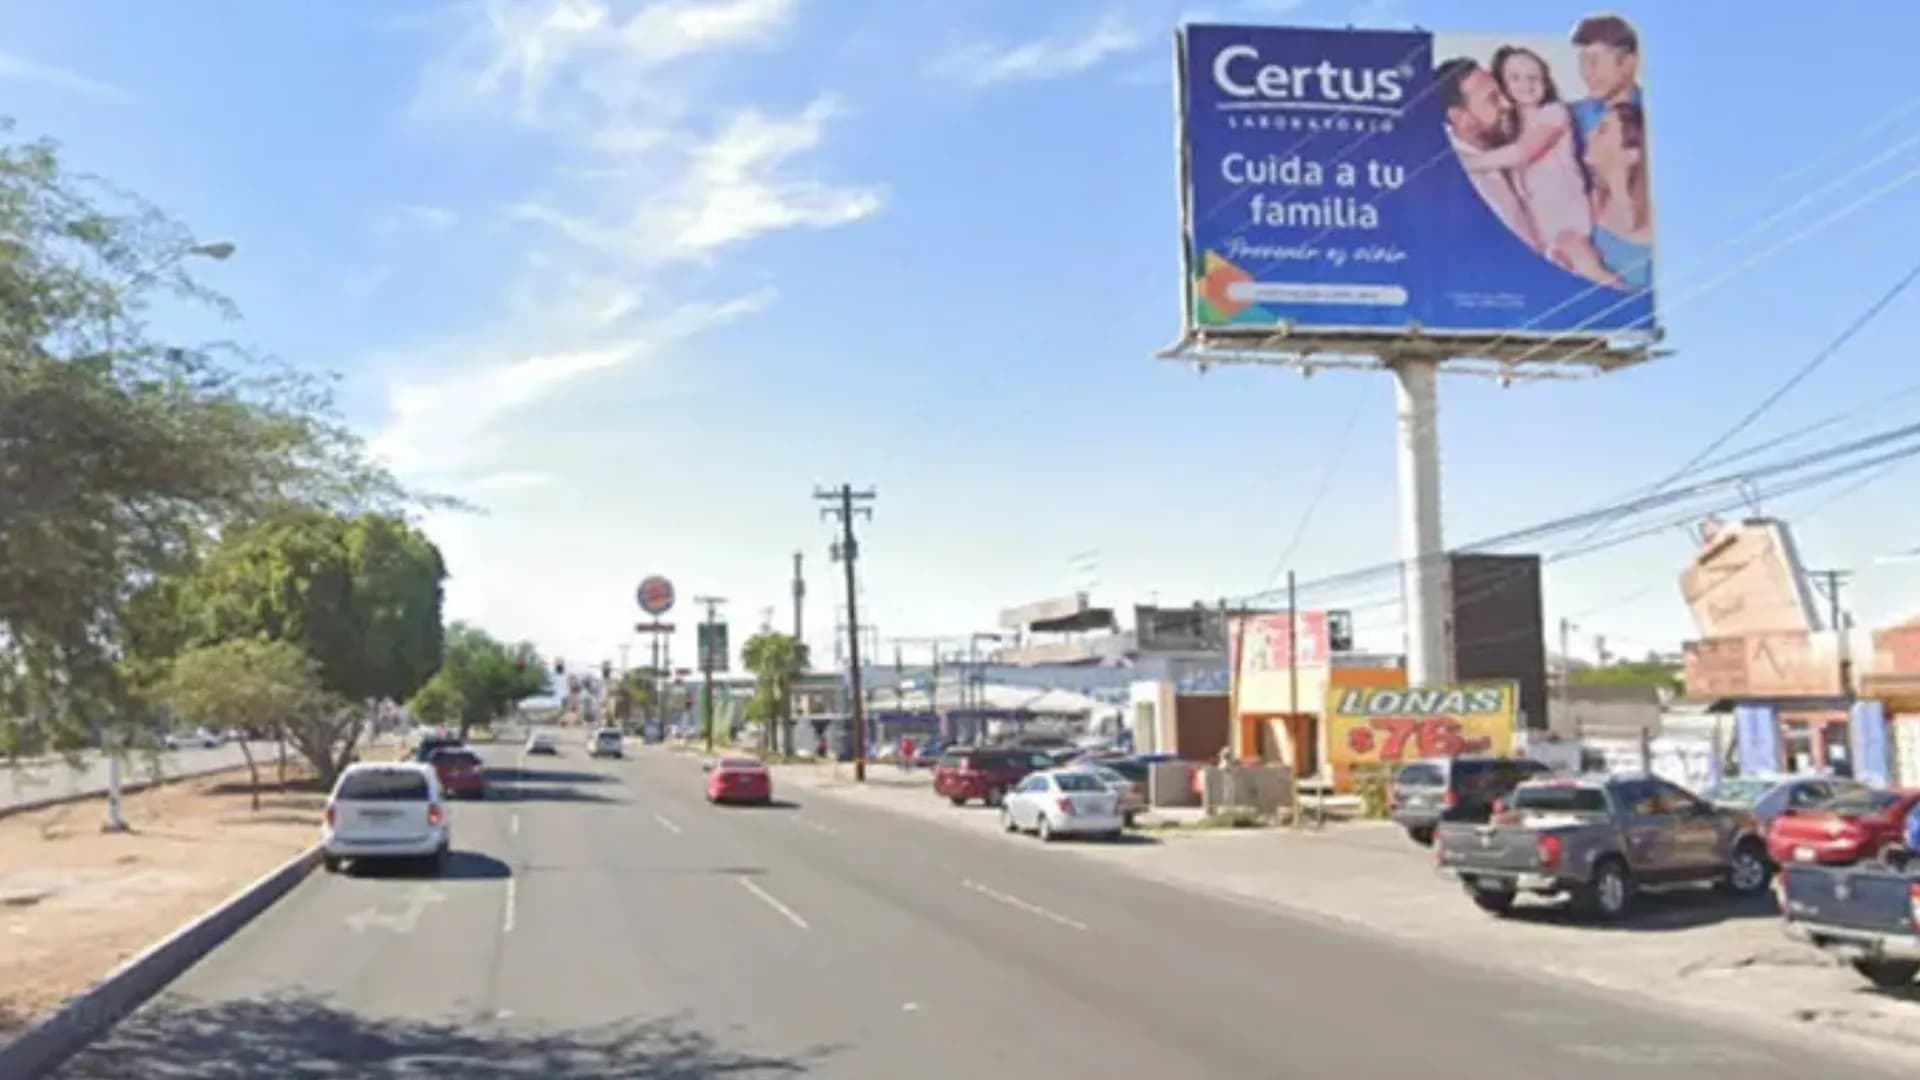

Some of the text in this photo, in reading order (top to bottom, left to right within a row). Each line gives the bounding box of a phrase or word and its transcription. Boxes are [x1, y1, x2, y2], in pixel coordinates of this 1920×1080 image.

[1228, 114, 1395, 134] LABORATORIO
[1221, 152, 1405, 189] Cuida a tu
[1249, 192, 1379, 230] familia
[1338, 687, 1503, 716] LONAS
